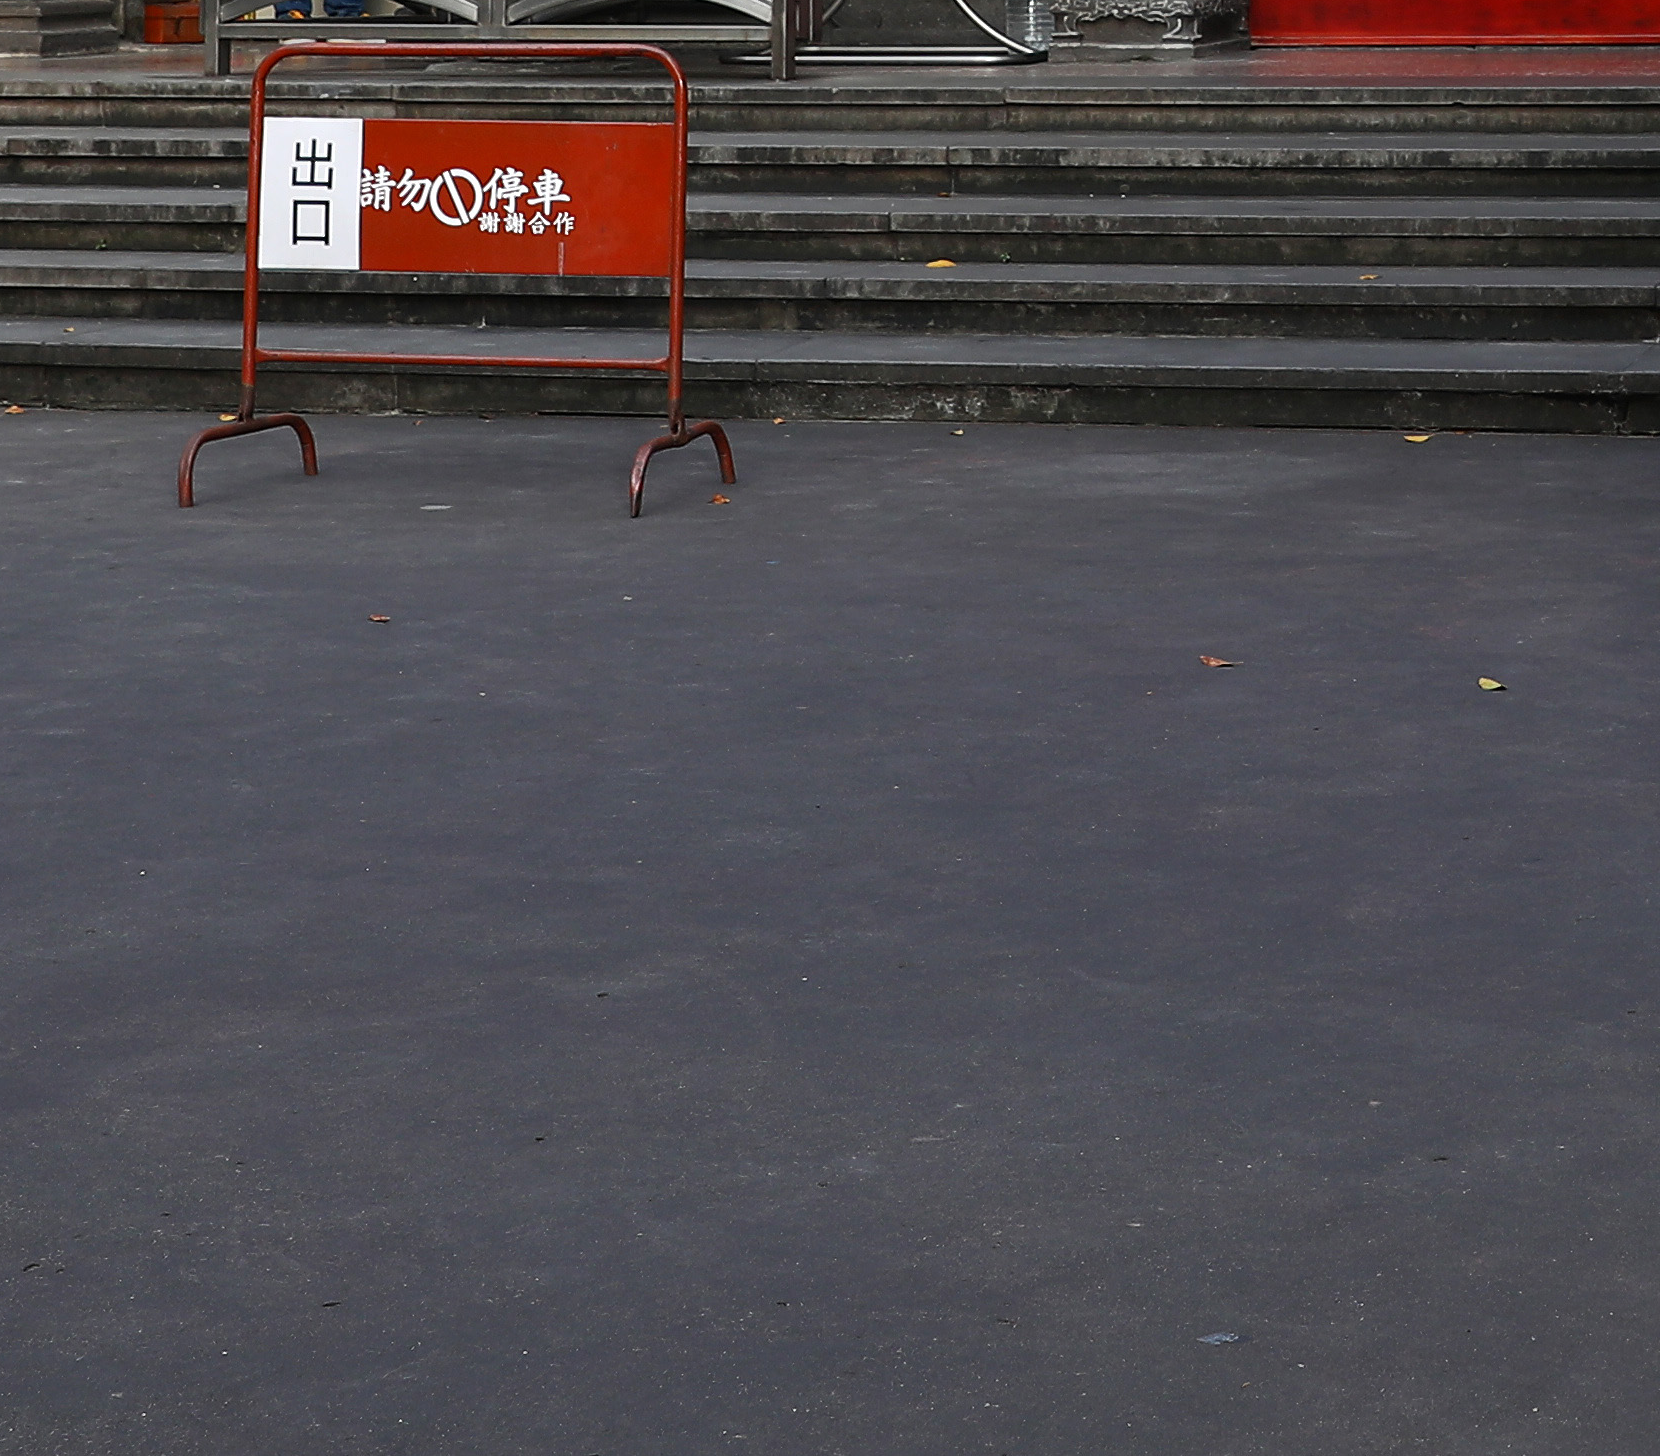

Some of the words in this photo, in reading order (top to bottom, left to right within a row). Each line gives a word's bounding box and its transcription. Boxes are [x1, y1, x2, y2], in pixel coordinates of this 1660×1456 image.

[290, 137, 334, 247] 出口
[478, 211, 575, 236] 謝謝合作
